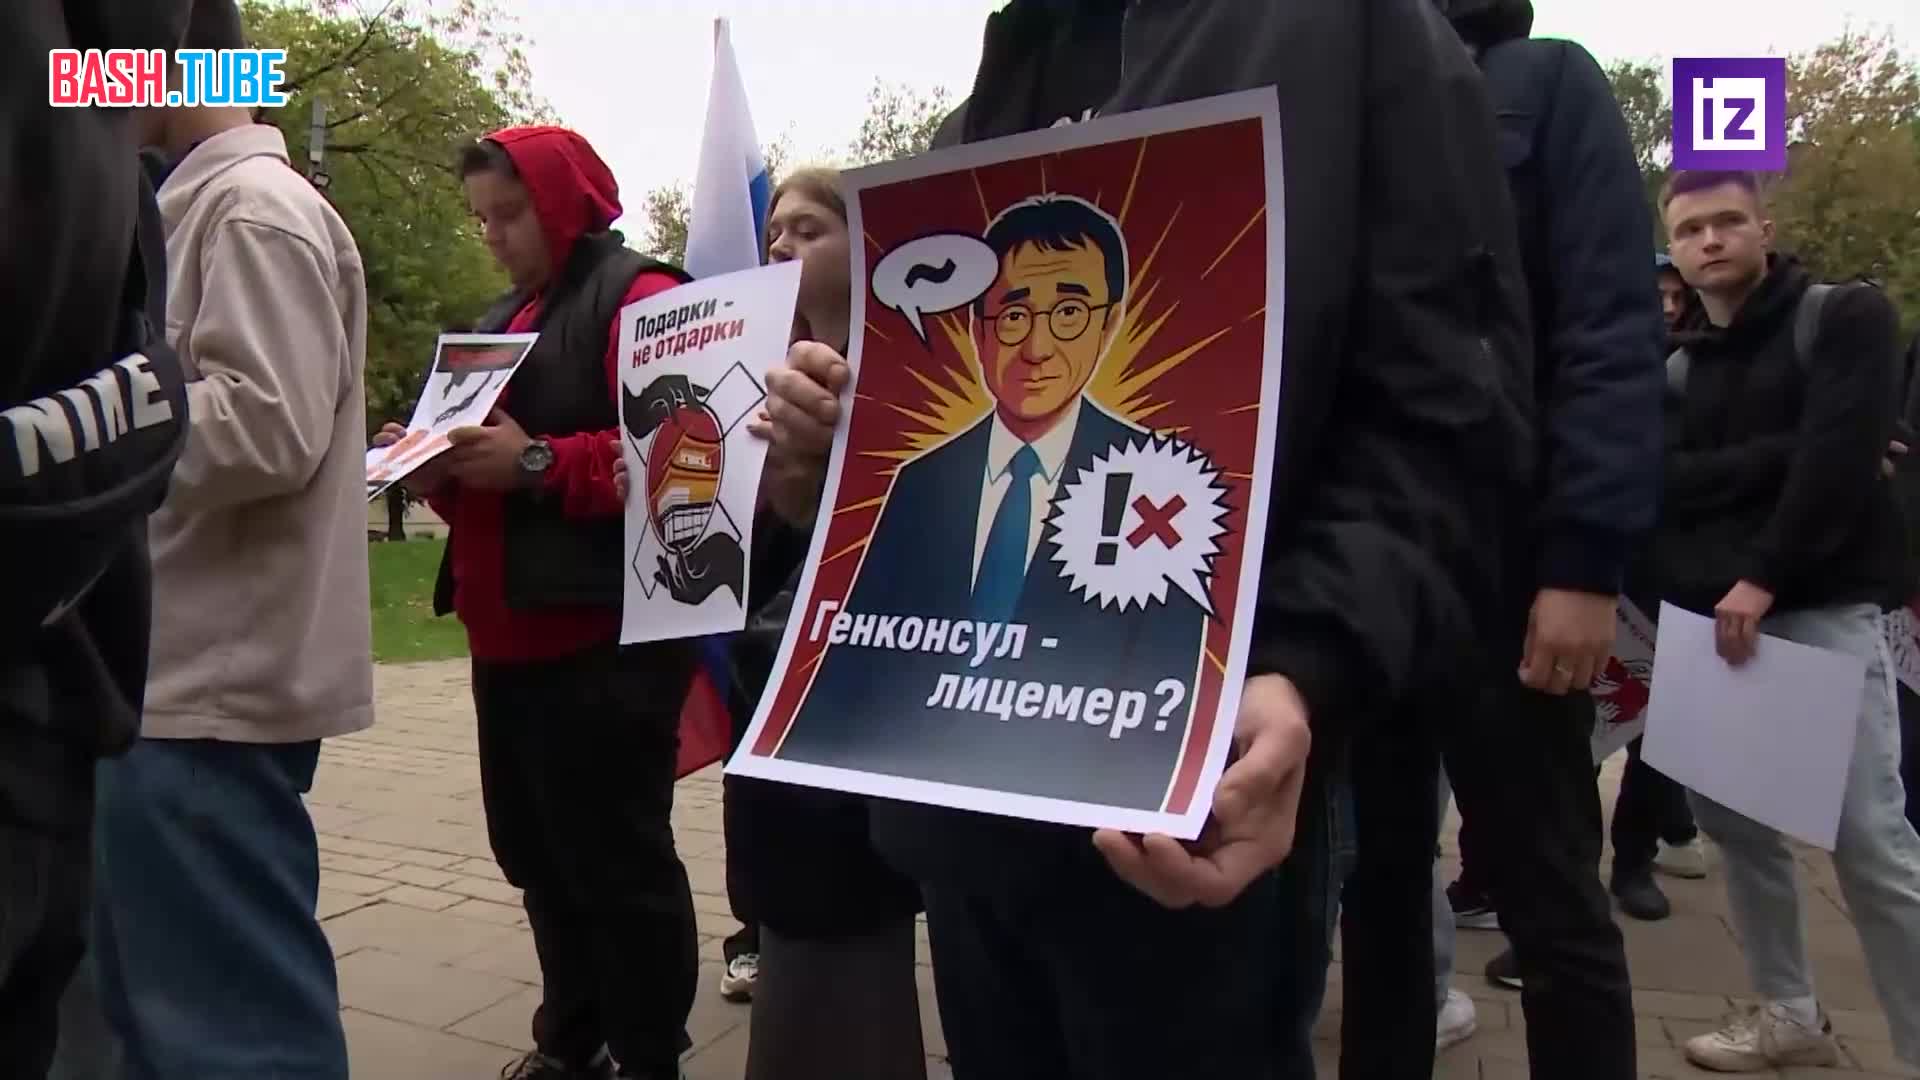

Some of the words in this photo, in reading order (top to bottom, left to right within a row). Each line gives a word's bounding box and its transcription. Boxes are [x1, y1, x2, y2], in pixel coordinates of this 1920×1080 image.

[632, 345, 651, 368] не
[655, 319, 744, 359] отдарки
[634, 298, 717, 342] Подарки
[809, 600, 1028, 668] Генконсул
[926, 673, 1186, 739] лицемер?
